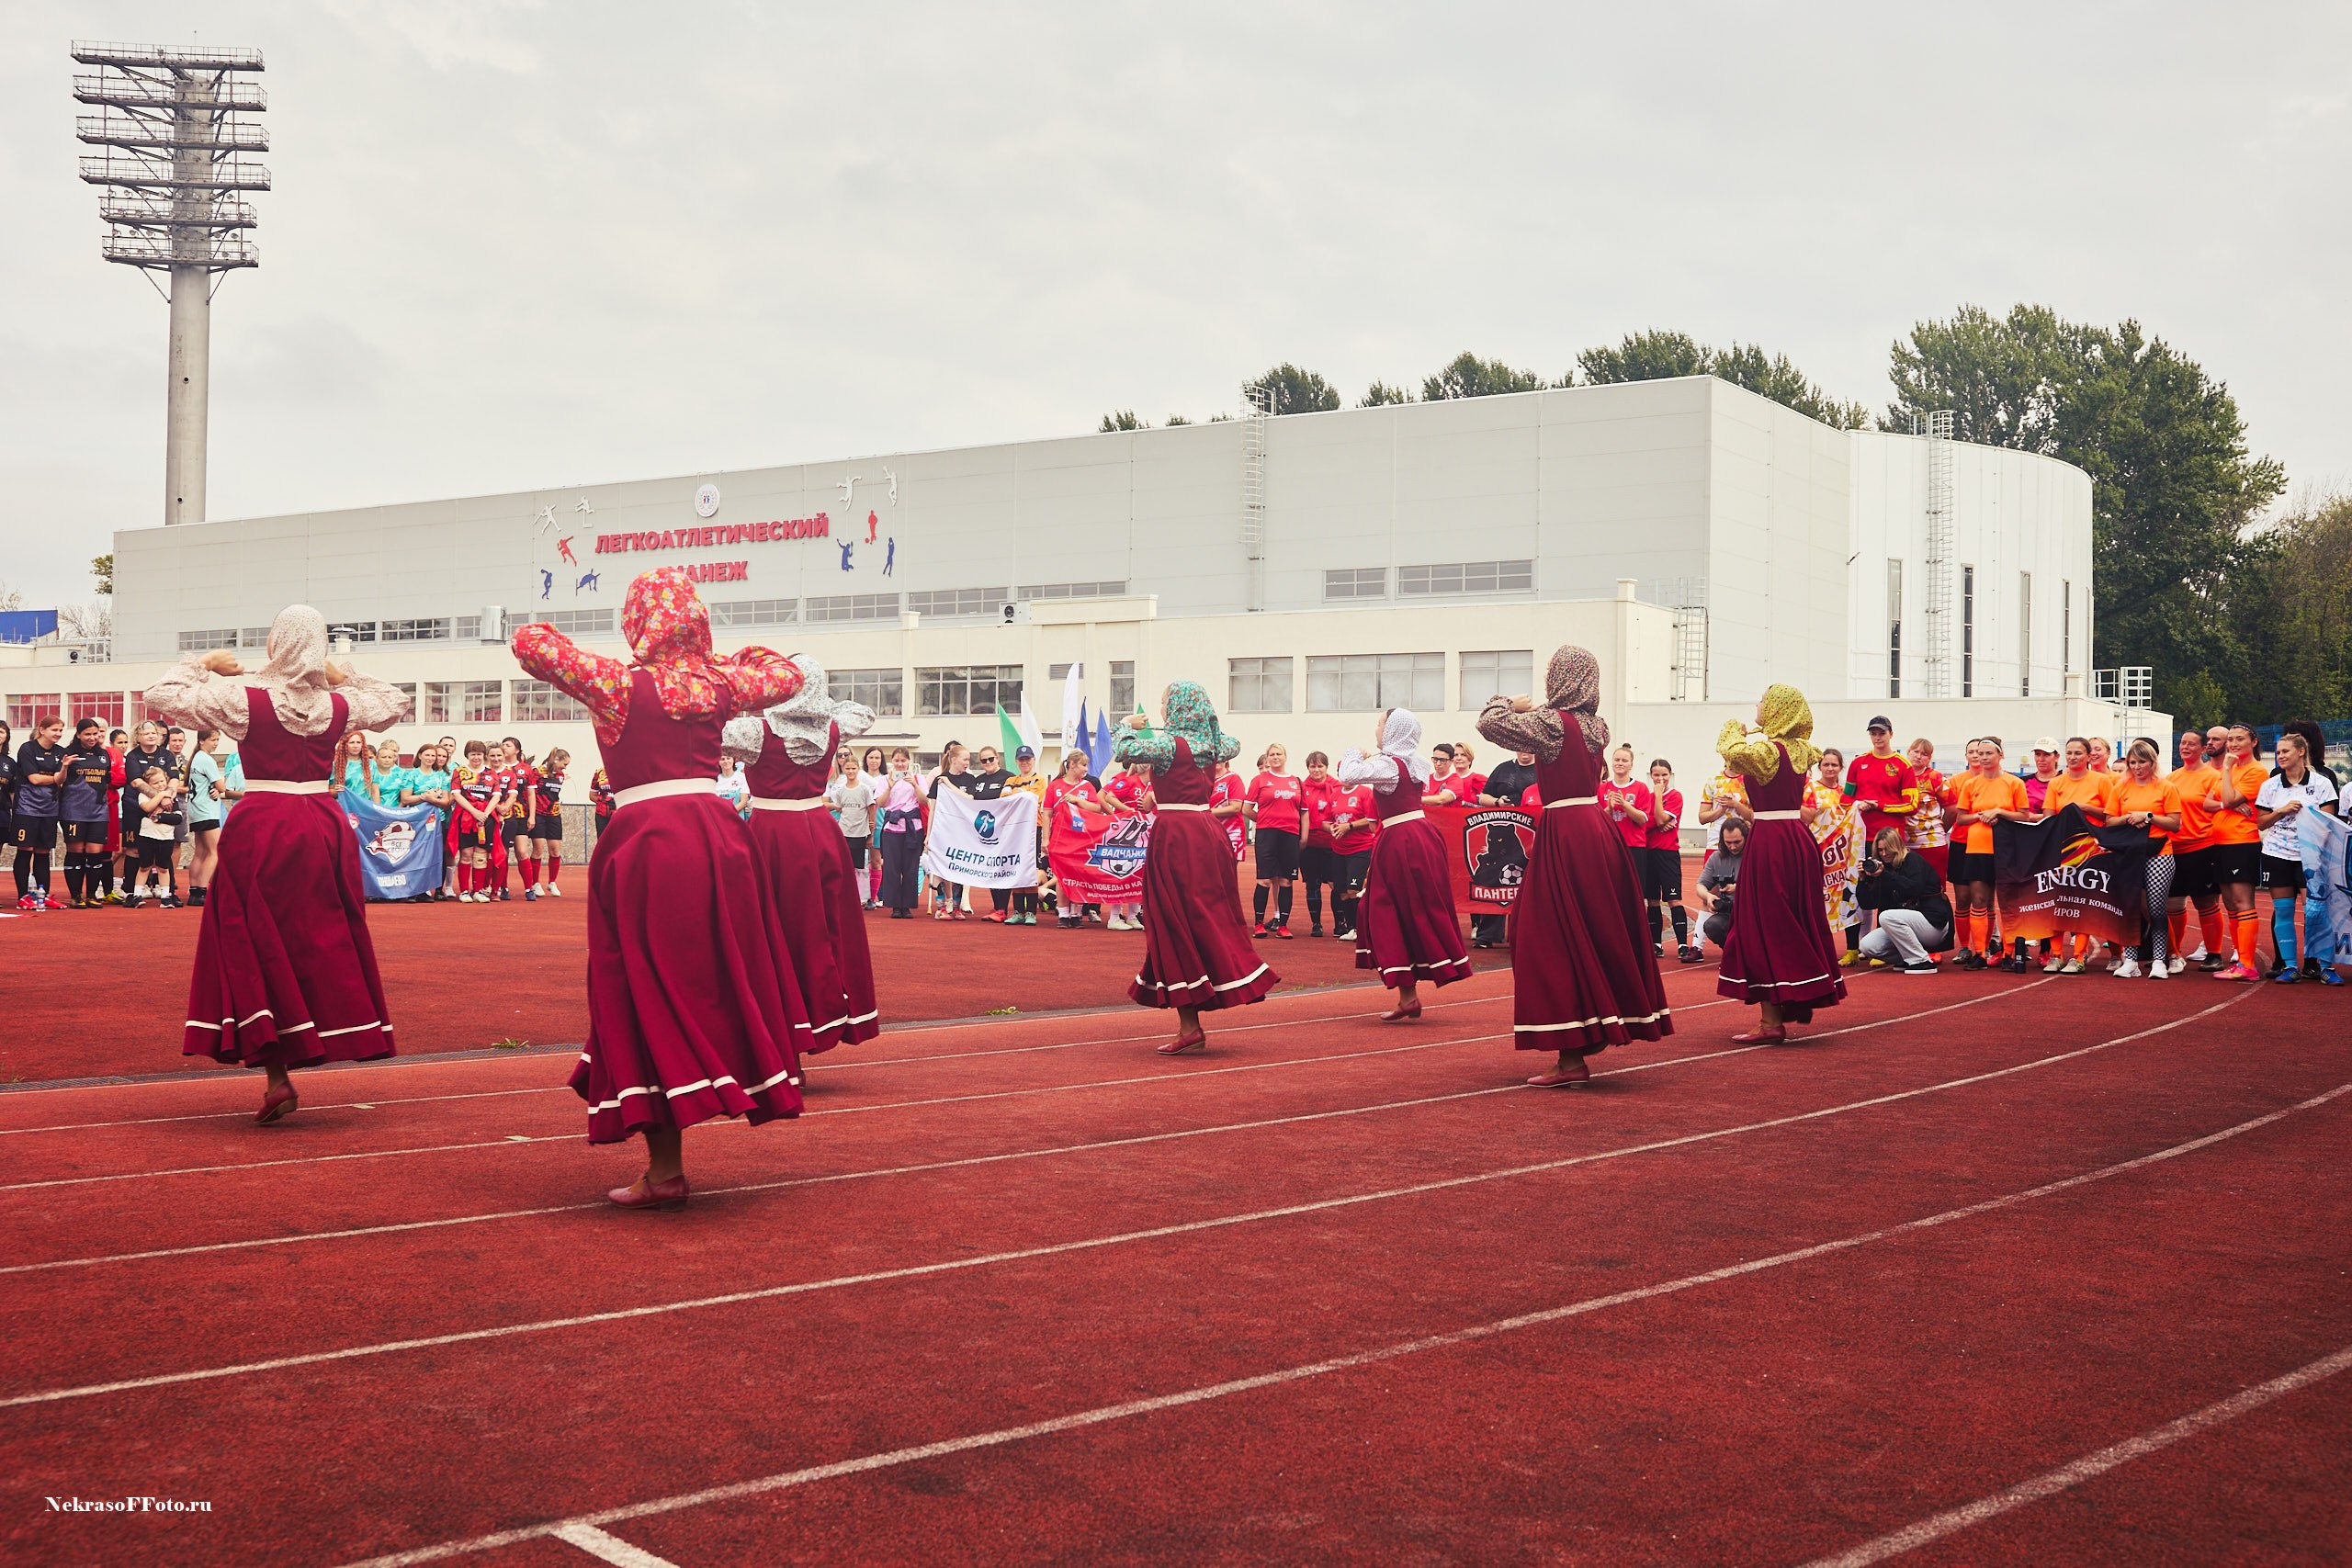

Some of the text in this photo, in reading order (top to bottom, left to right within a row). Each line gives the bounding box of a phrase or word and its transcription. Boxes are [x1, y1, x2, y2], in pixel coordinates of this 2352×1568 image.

[595, 513, 829, 554] ЛЕГКОАТЛЕТИЧЕСКИЙ
[1055, 788, 1062, 797] 6
[1467, 811, 1532, 826] ВЛАДИМИРСКИЕ
[18, 829, 26, 841] 9
[945, 847, 1021, 867] ЦЕНТР СПОРТА
[1101, 848, 1147, 858] ВАДЧАНКА
[2262, 872, 2270, 882] 37
[1062, 877, 1092, 889] СТРАСТЬ
[1093, 883, 1125, 892] ПОБЕДЫ
[1125, 882, 1131, 890] В
